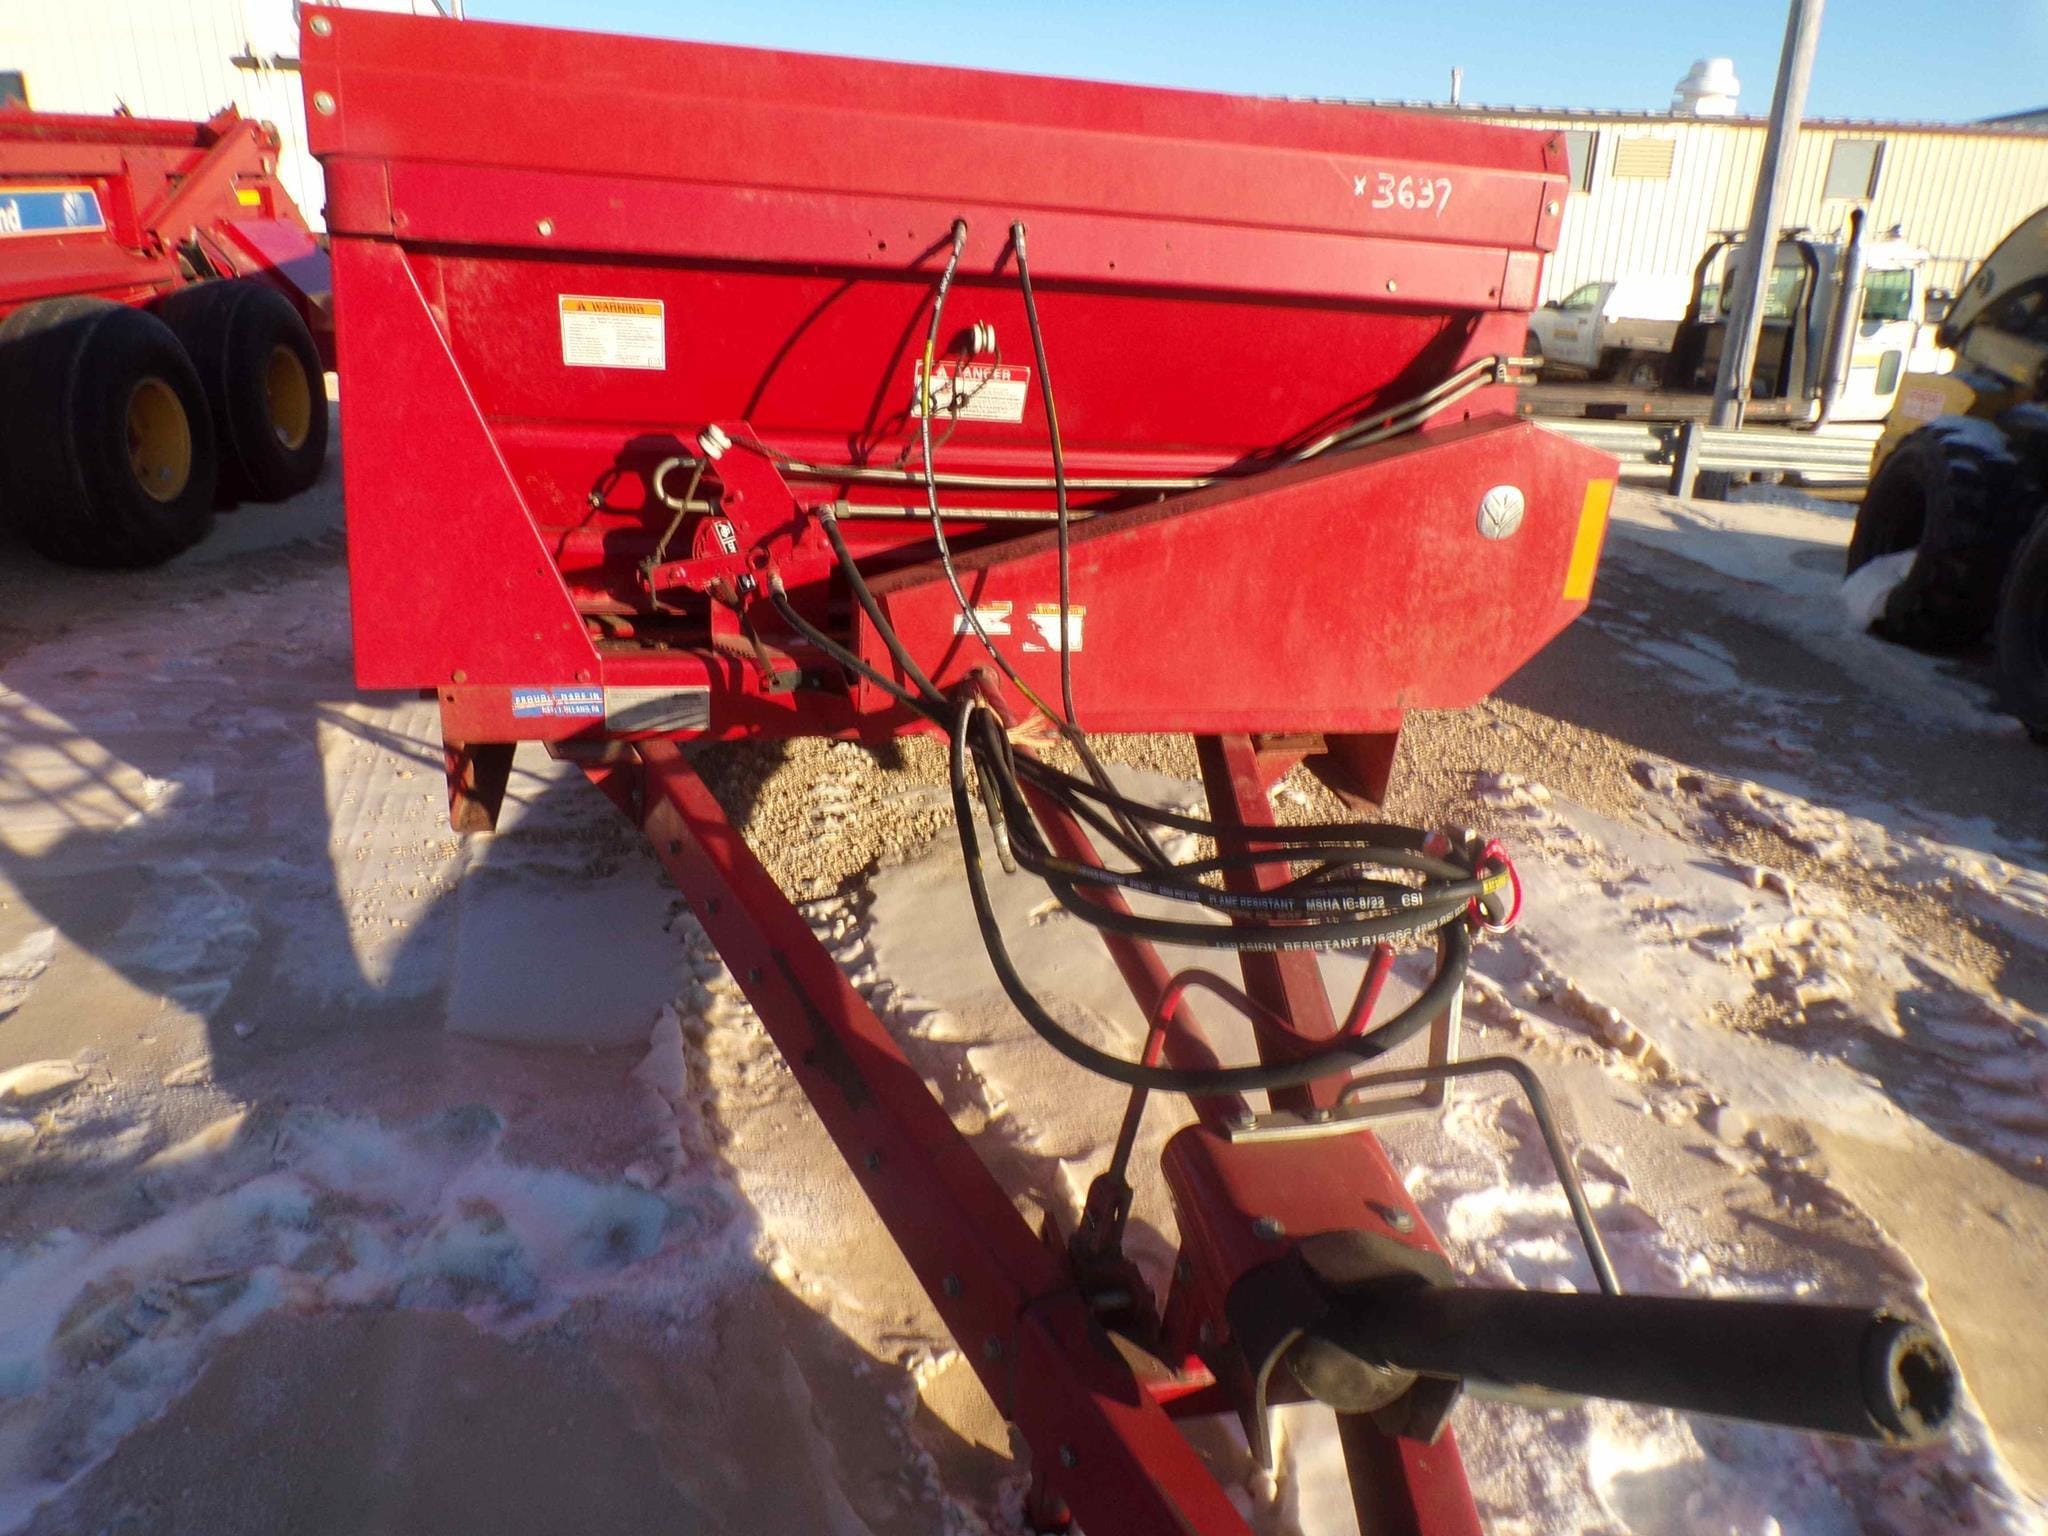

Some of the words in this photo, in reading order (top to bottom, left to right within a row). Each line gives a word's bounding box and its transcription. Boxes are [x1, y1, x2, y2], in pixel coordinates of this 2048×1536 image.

[1371, 171, 1453, 219] 3637
[591, 300, 646, 315] WARNING
[1240, 896, 1296, 911] RESISTANT
[1305, 897, 1341, 912] MSHA
[1283, 936, 1359, 952] RESISTANT
